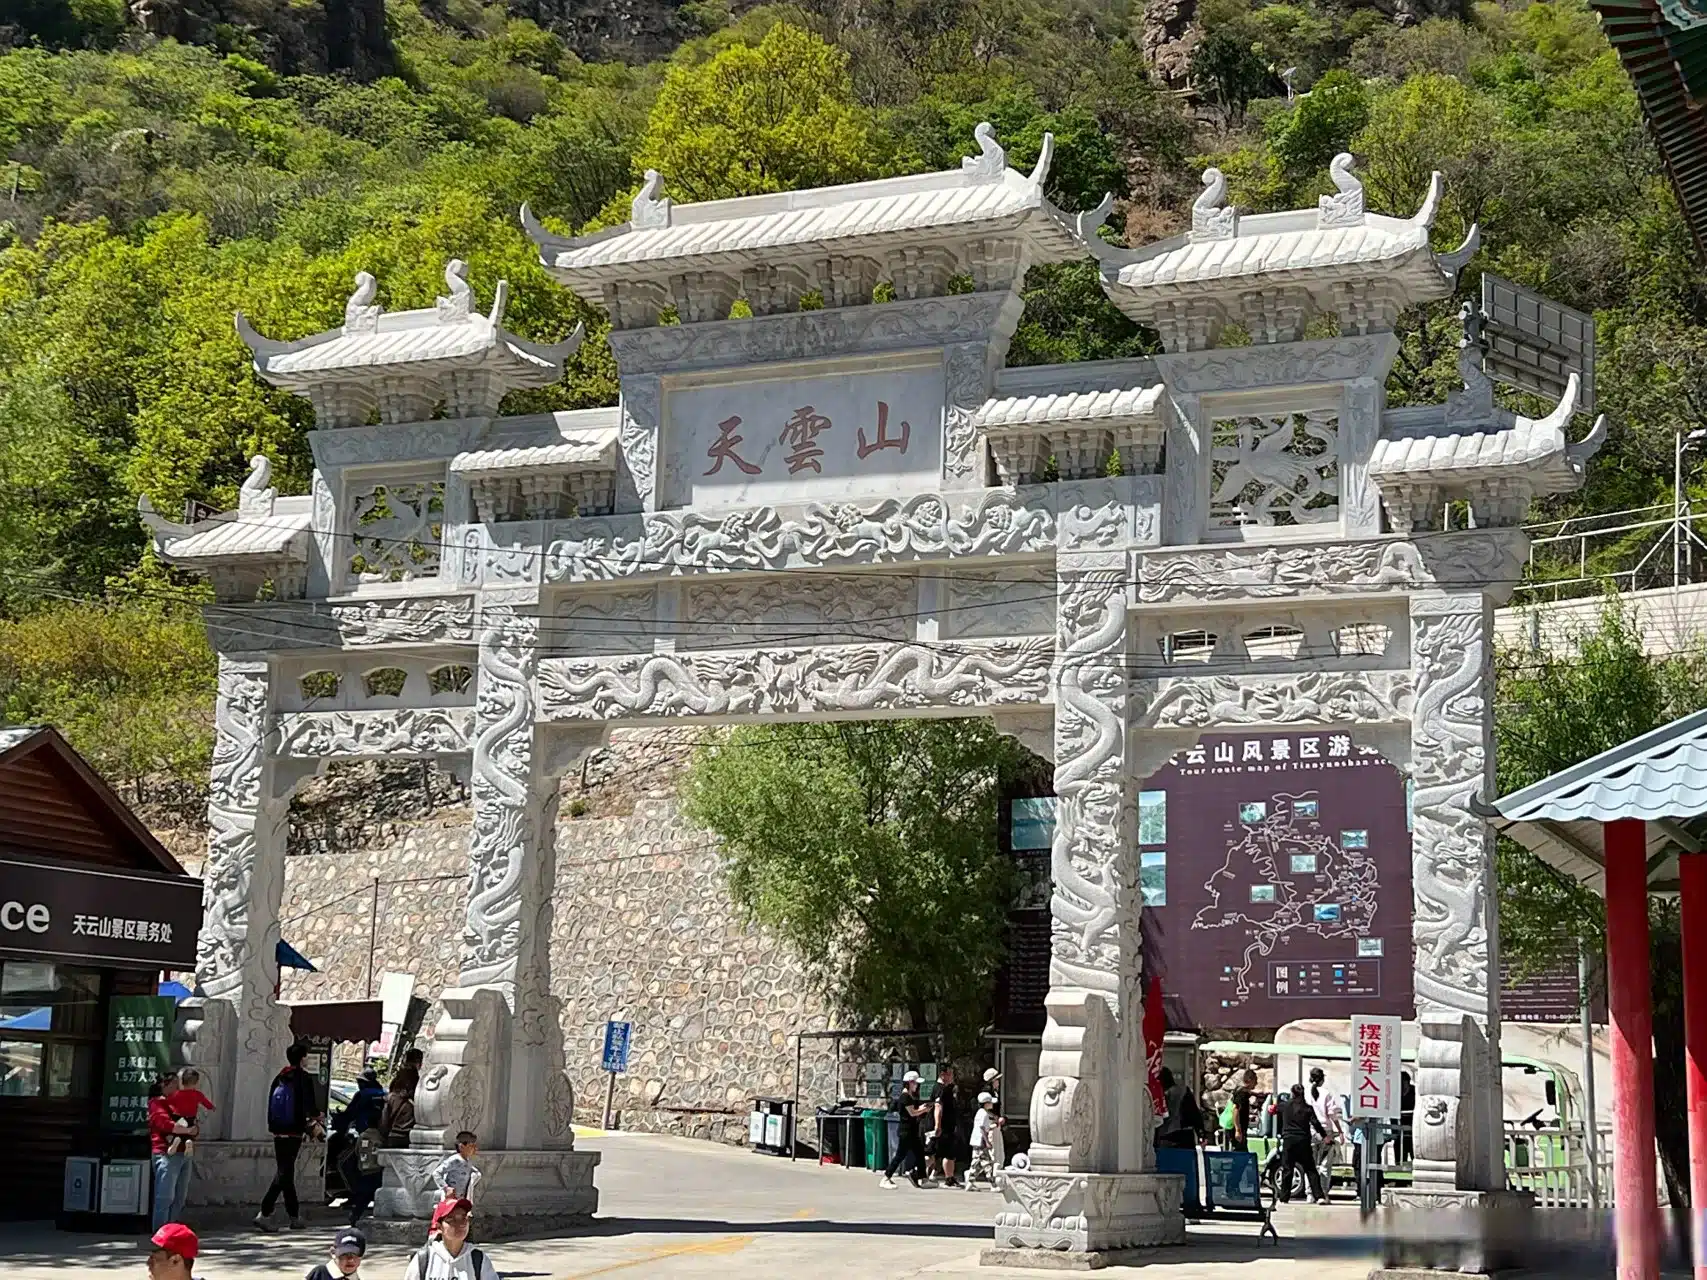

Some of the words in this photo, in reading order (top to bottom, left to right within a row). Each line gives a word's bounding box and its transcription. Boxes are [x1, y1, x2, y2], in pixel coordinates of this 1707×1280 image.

[702, 401, 911, 476] 天雲山
[1180, 768, 1206, 776] Tour
[1211, 766, 1242, 774] route
[1247, 765, 1270, 773] map
[1275, 762, 1287, 771] of
[1, 901, 50, 933] ce
[72, 914, 173, 943] 天云山景区票务处
[116, 1016, 164, 1028] 天云山景区
[1359, 1024, 1382, 1109] 摆渡车入口
